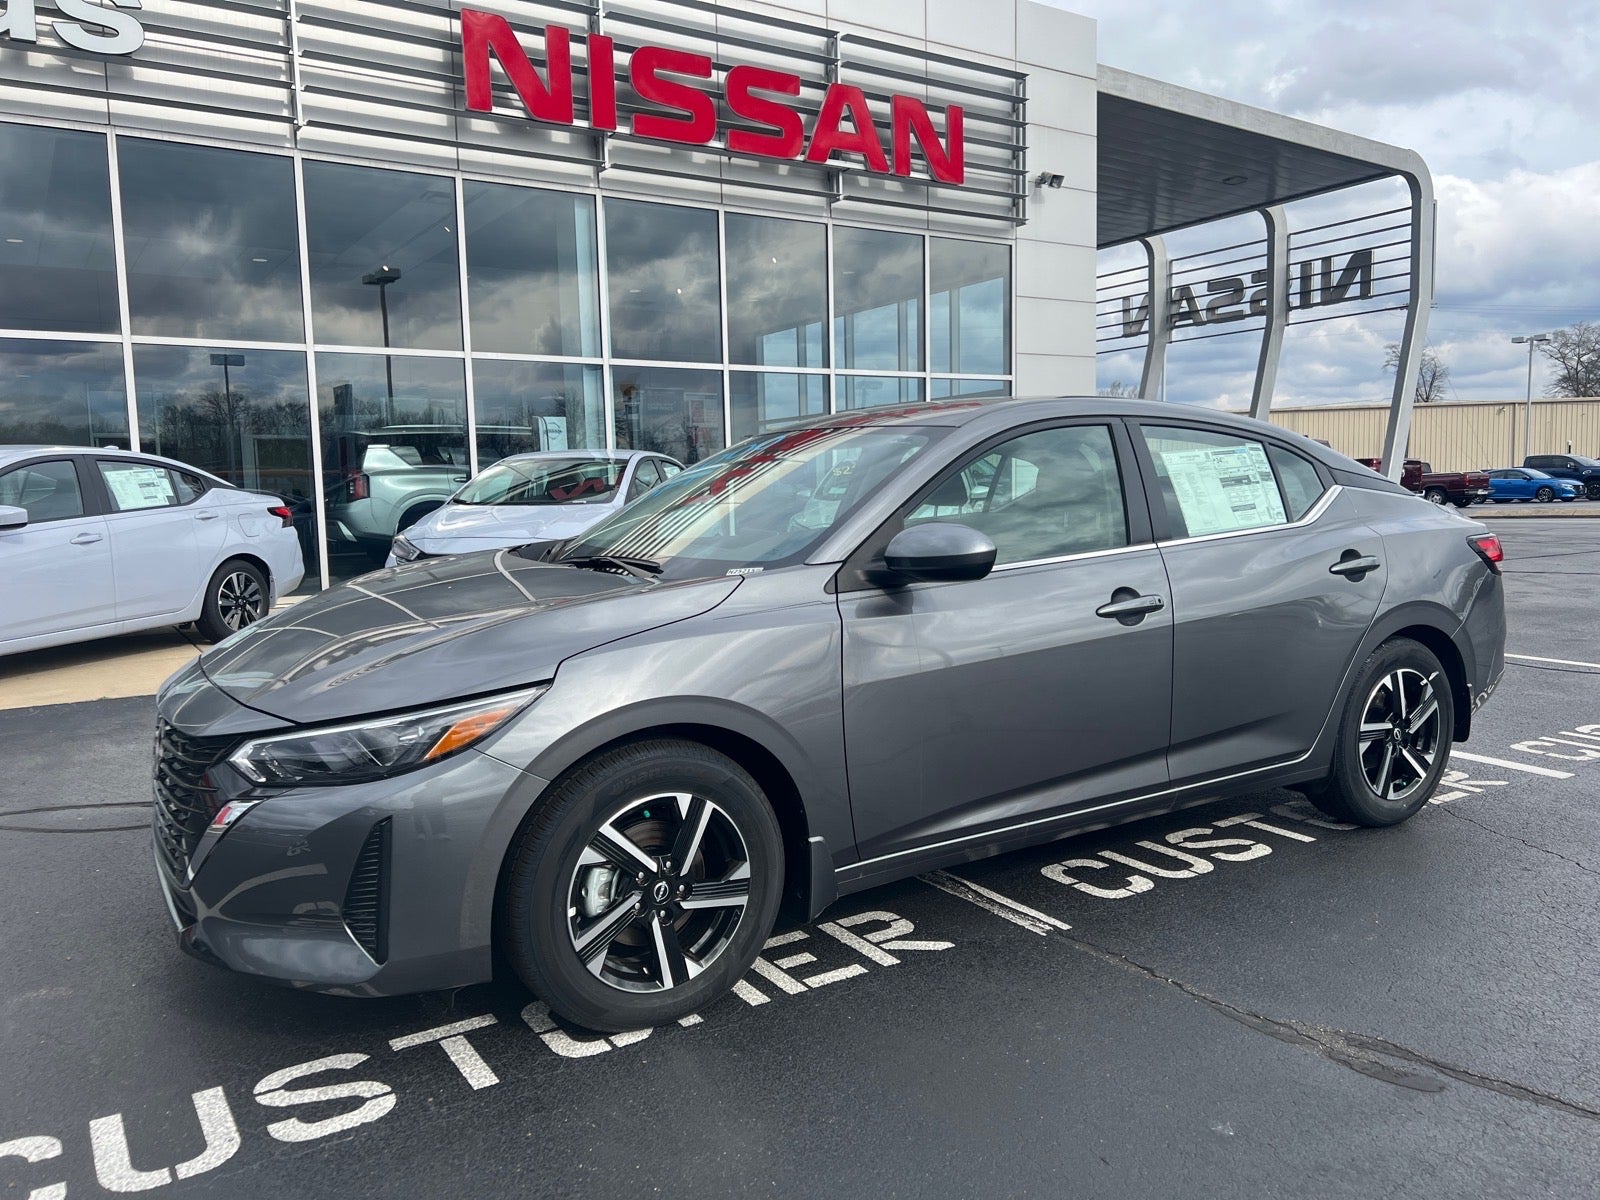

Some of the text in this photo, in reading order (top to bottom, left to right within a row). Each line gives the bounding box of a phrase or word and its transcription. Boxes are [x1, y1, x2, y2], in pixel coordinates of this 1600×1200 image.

[0, 0, 145, 55] s
[460, 9, 964, 185] NISSAN
[1040, 768, 1509, 900] CUSTR
[0, 910, 956, 1200] USTER
